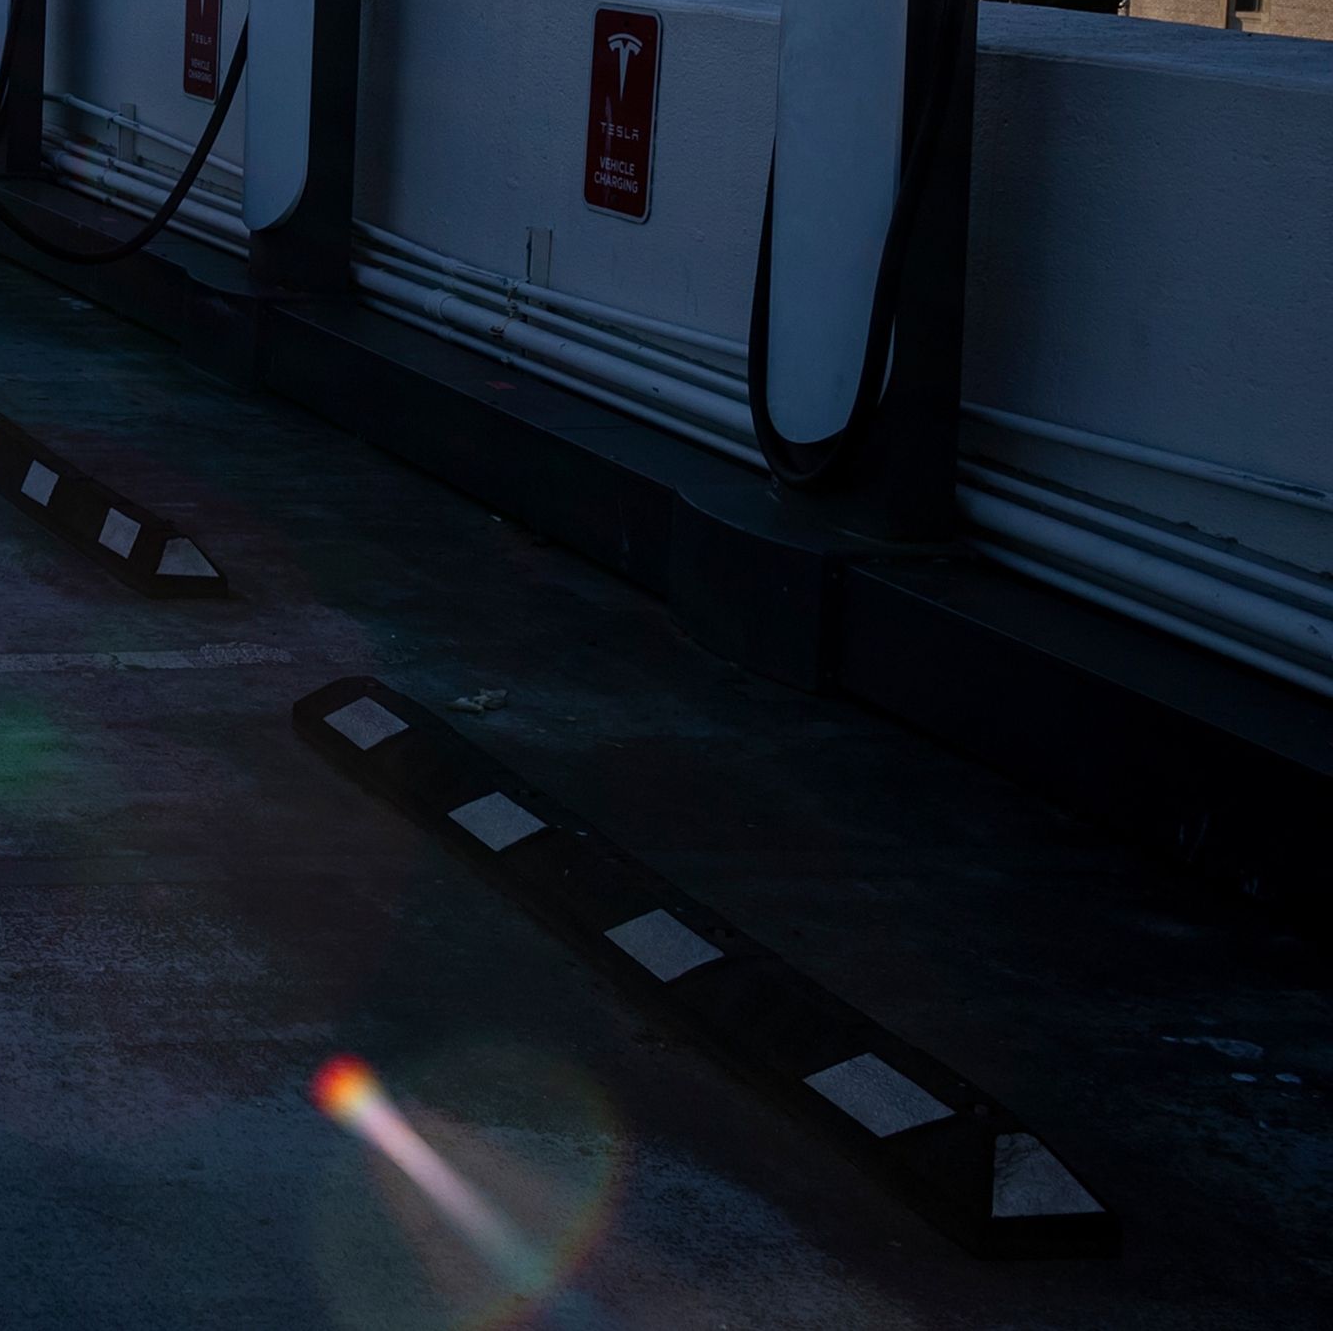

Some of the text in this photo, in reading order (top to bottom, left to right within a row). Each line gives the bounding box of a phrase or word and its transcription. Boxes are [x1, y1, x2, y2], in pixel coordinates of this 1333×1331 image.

[190, 31, 213, 45] TESLA
[600, 121, 640, 143] TESLA
[599, 155, 636, 177] VEHICLE
[593, 170, 639, 195] CHARGING
